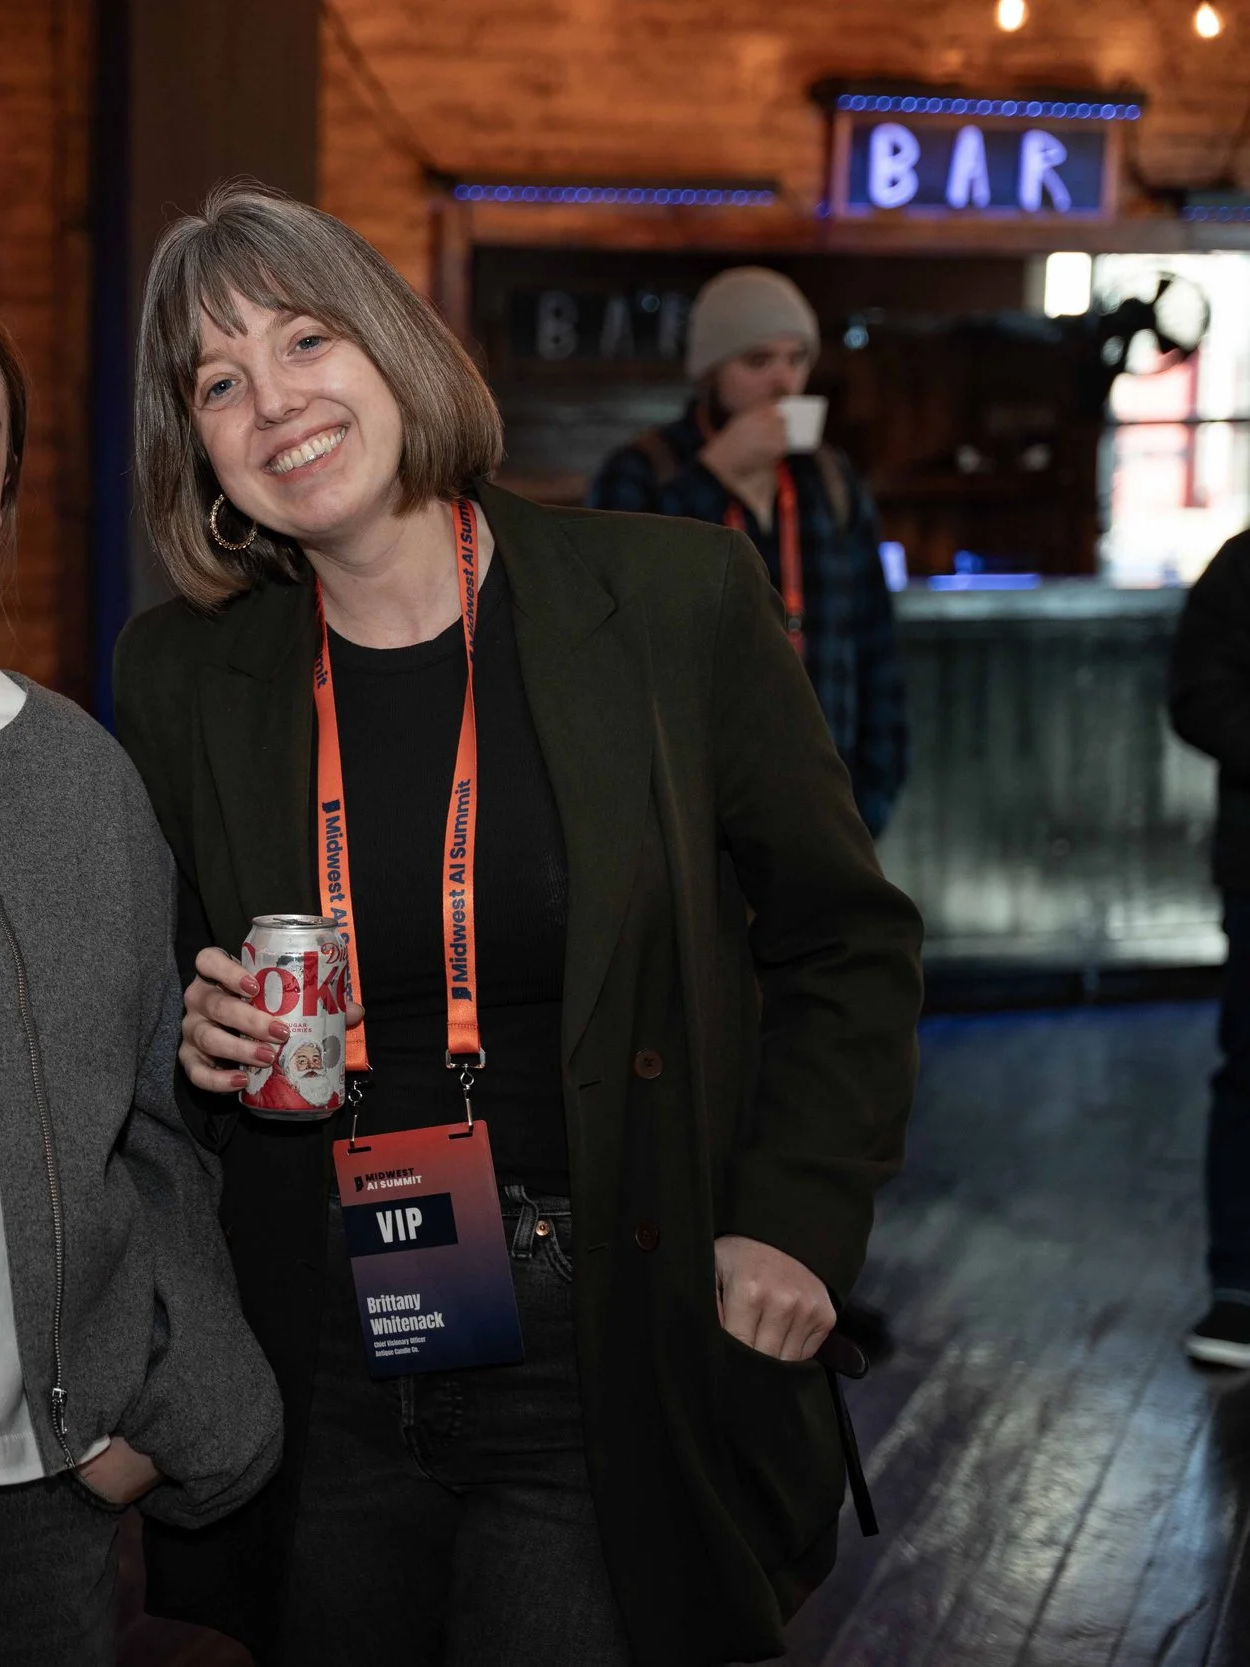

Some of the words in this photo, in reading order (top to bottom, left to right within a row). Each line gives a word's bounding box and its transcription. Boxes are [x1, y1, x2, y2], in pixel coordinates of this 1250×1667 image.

[868, 122, 1072, 213] BAR
[457, 500, 473, 544] Sum
[462, 547, 473, 566] AI
[463, 568, 476, 647] Midwest
[316, 654, 328, 689] mit
[450, 779, 471, 859] Summit
[325, 815, 345, 902] Midwest
[449, 864, 465, 884] AI
[449, 889, 467, 982] Midwest
[242, 942, 347, 1016] ok
[365, 1168, 414, 1181] MIDWEST
[367, 1182, 378, 1191] AI
[380, 1175, 422, 1189] SUMMIT
[376, 1207, 423, 1243] VIP
[367, 1294, 421, 1314] Brittany
[370, 1311, 445, 1336] Whitenack
